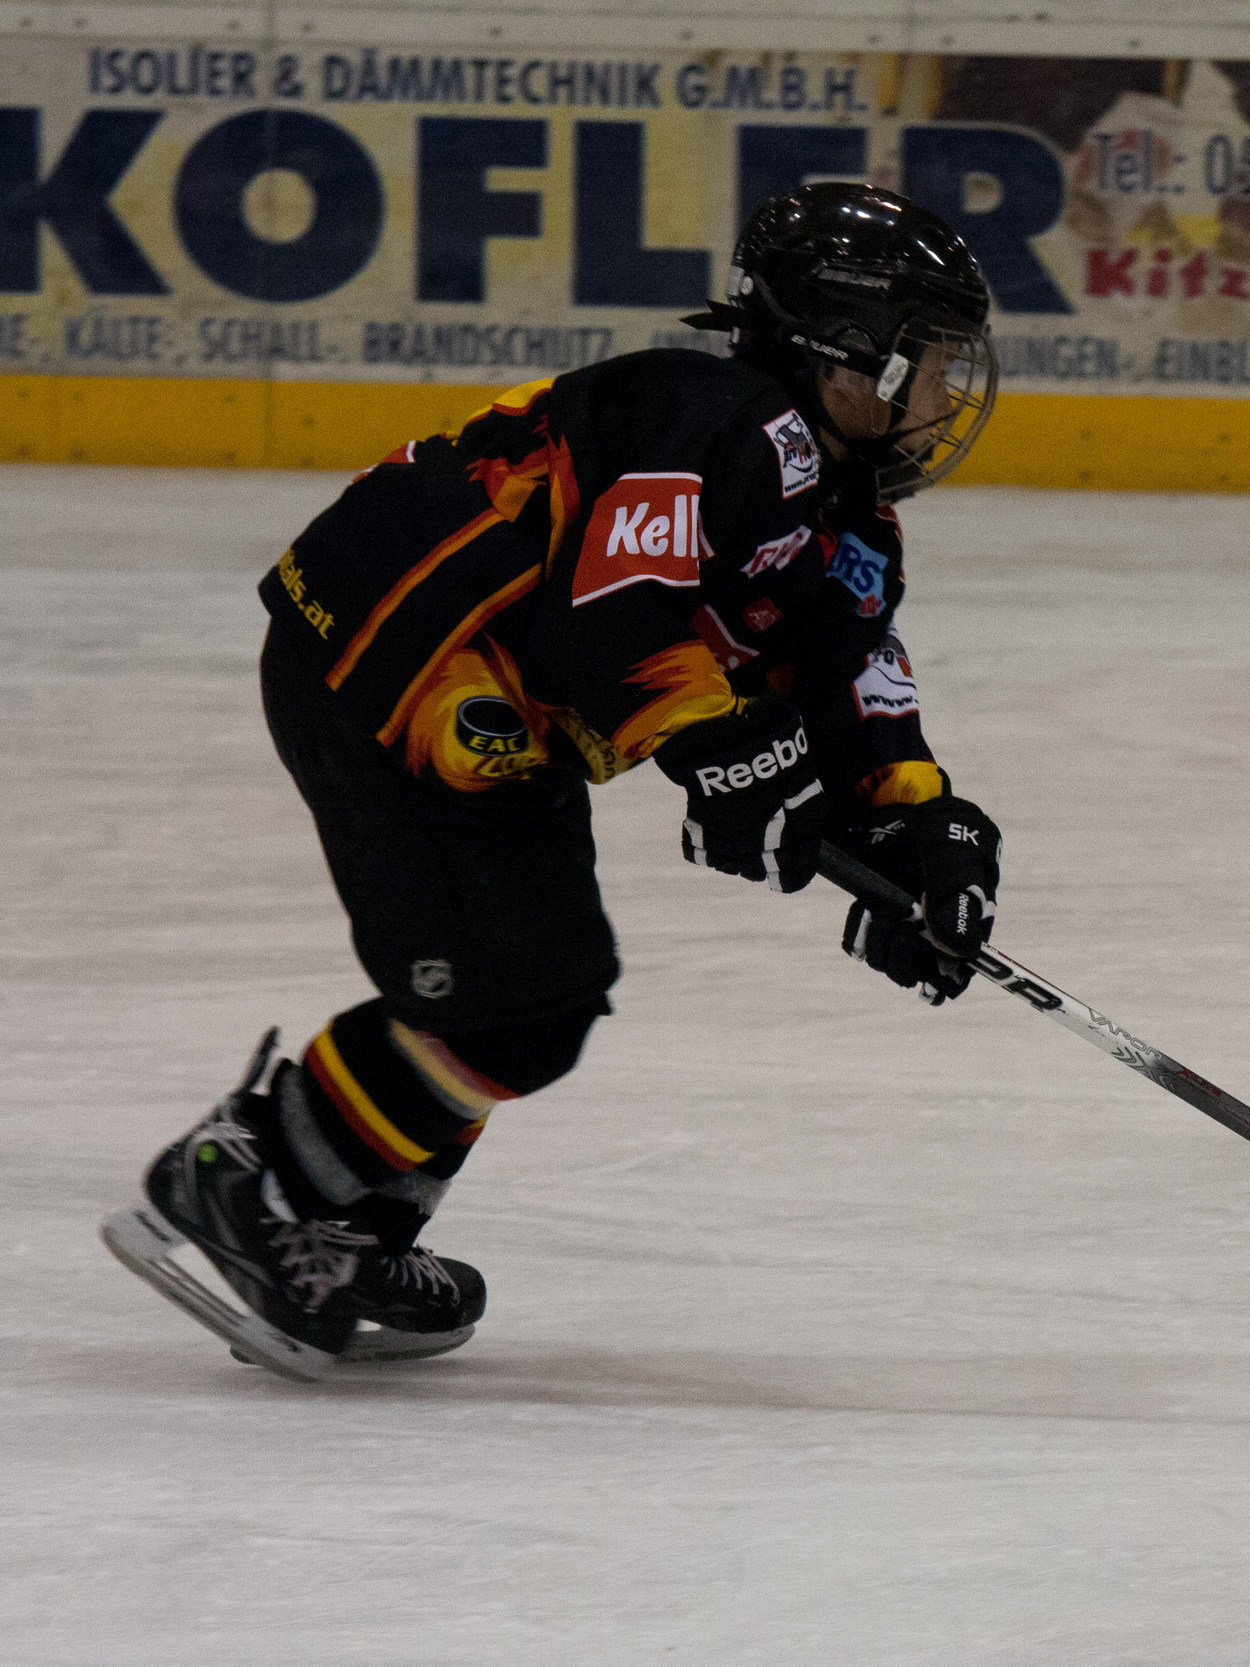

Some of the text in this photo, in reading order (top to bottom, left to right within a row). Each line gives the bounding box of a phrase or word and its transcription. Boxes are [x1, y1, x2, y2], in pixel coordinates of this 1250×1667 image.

[274, 54, 303, 97] &
[322, 50, 661, 107] DÄMMTECHNIK
[606, 494, 700, 558] Kell
[836, 543, 881, 593] RS
[695, 725, 808, 797] Reebo
[956, 892, 969, 936] Reebok
